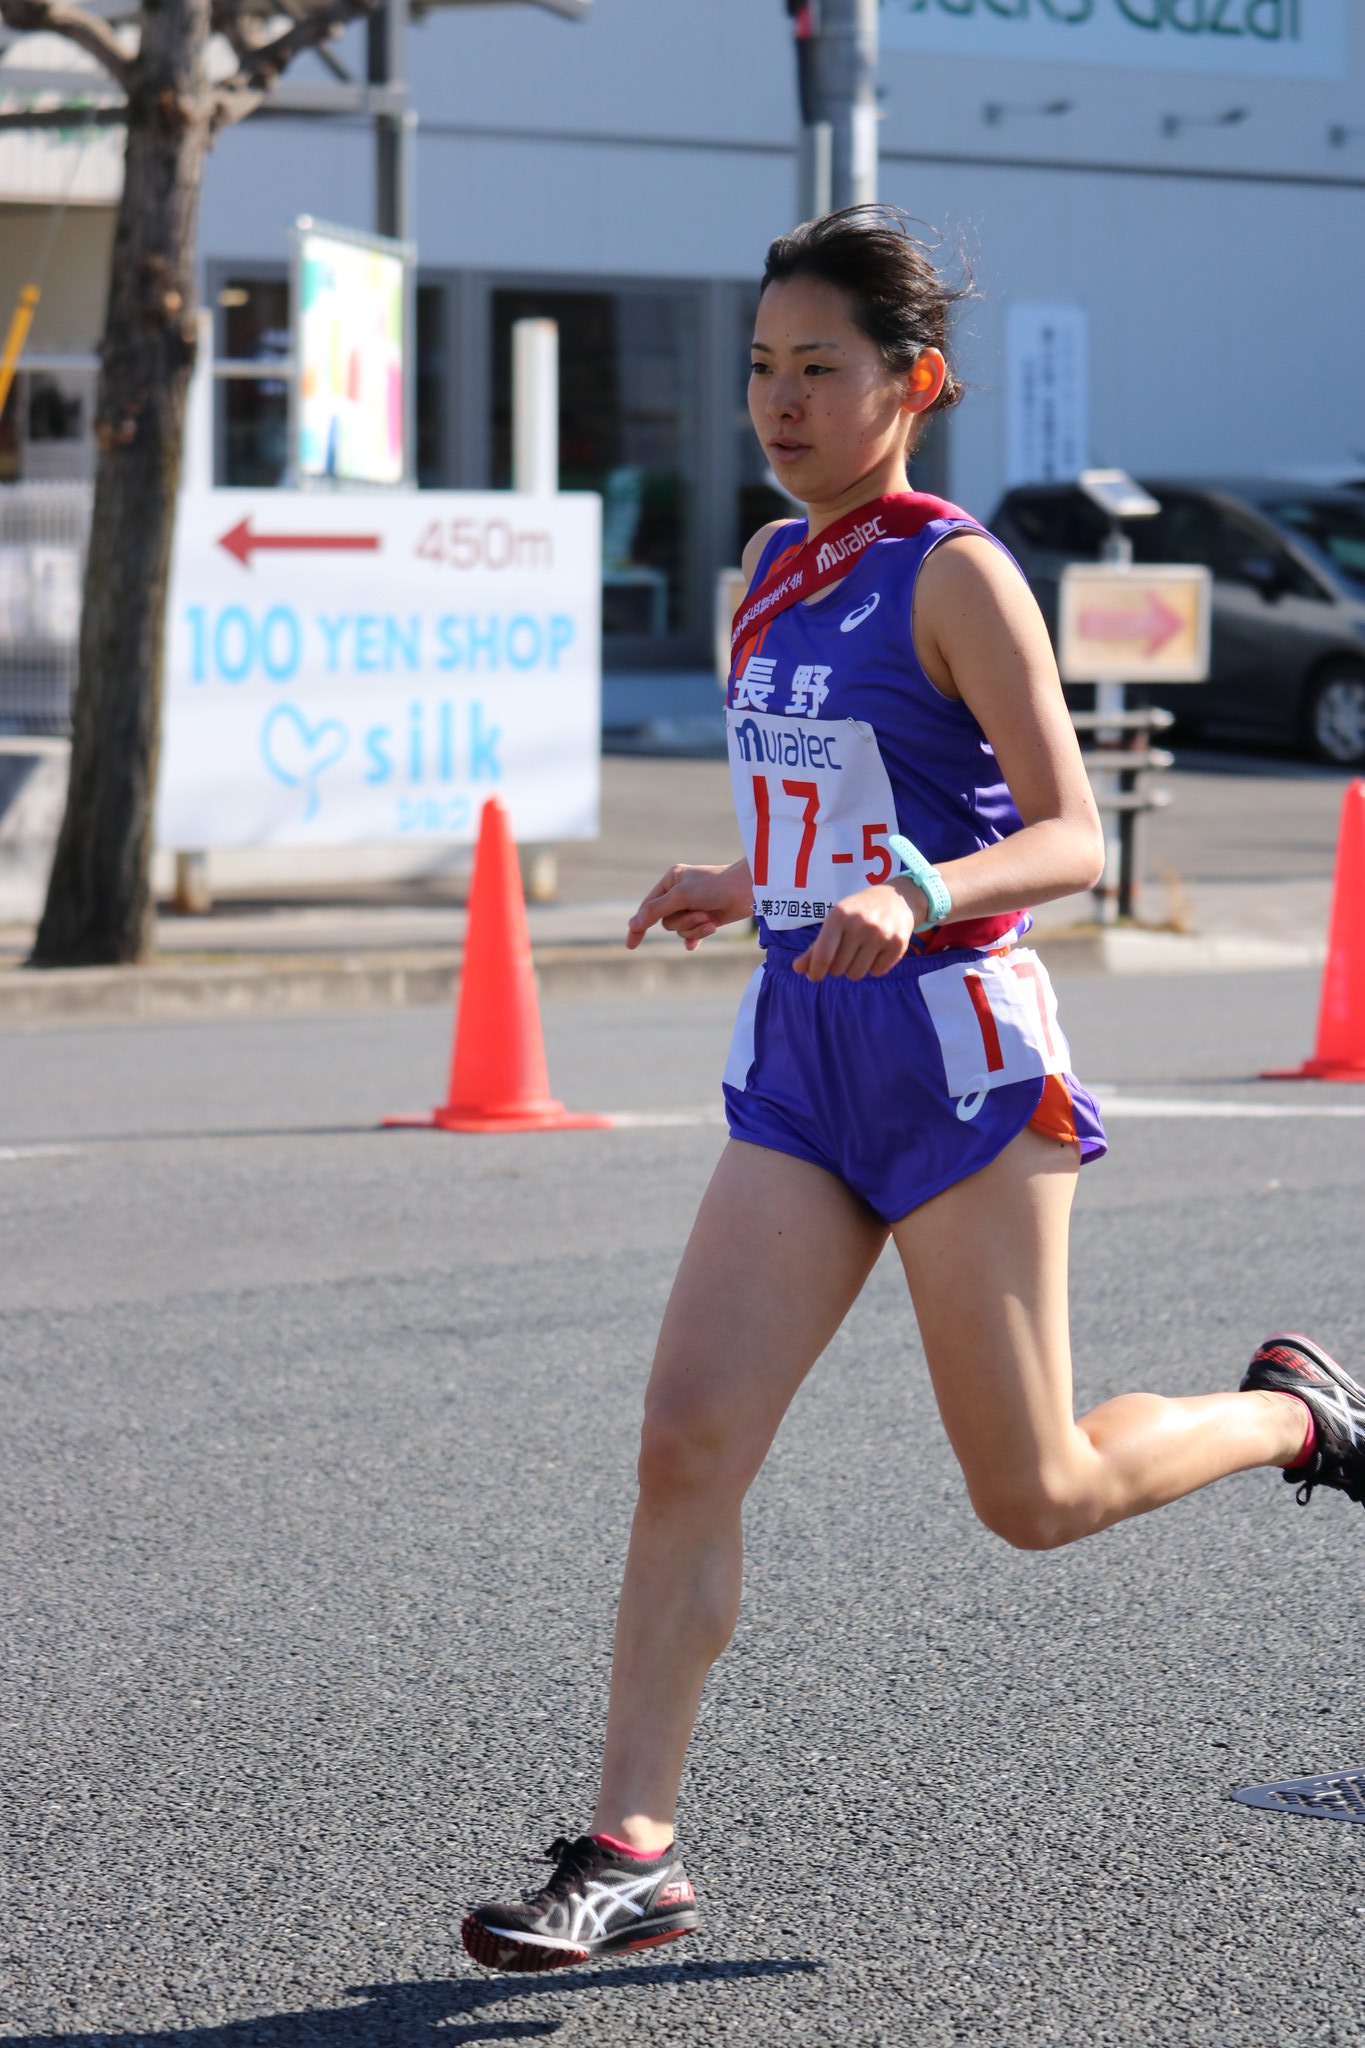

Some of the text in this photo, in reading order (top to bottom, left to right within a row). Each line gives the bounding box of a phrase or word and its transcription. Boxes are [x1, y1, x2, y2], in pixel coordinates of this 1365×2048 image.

[415, 517, 553, 571] 450m
[185, 604, 575, 684] 100 YEN SHOP
[732, 655, 833, 719] 長野
[364, 701, 503, 785] silk
[963, 961, 1055, 1073] 17
